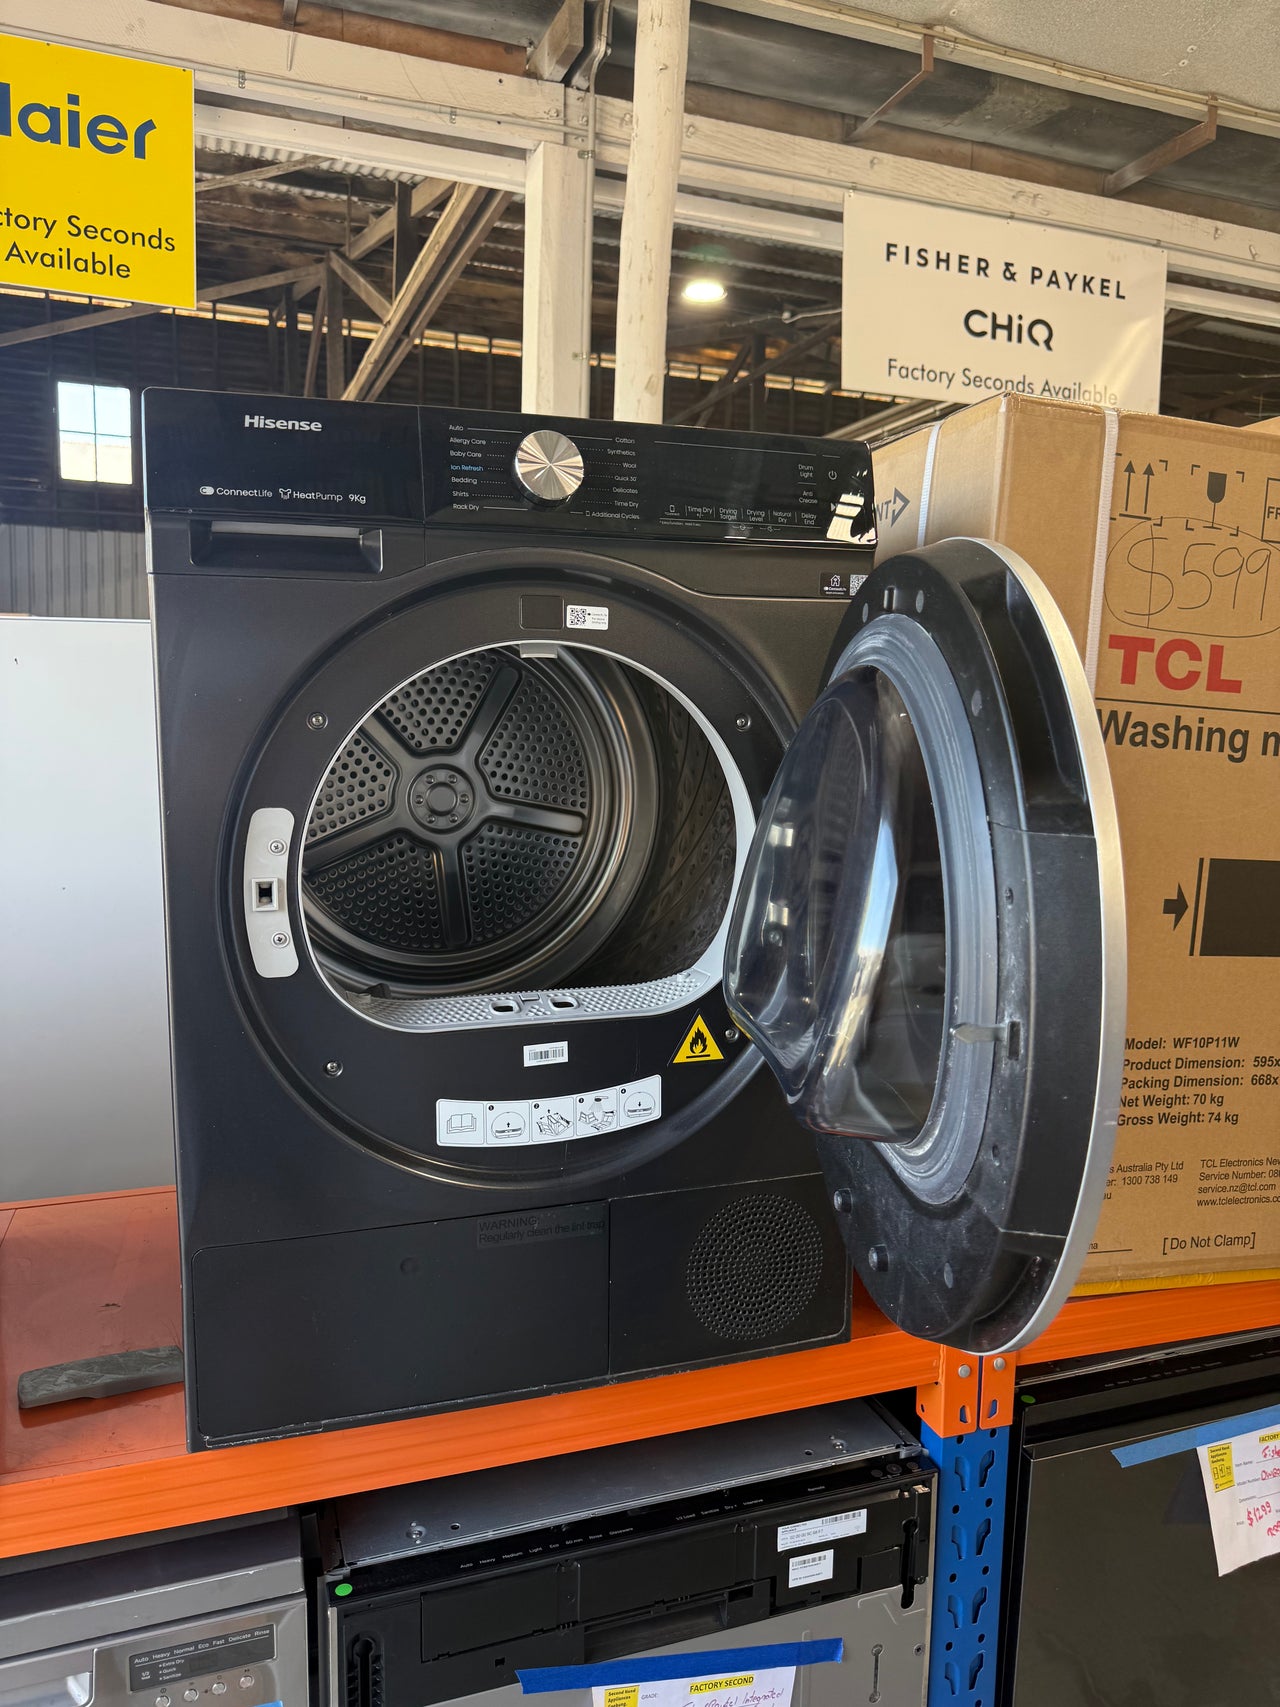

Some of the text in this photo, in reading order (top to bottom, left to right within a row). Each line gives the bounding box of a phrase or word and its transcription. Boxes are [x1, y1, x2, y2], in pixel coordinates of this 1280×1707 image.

[0, 207, 175, 251] tory Seconds
[5, 241, 130, 278] Available
[886, 243, 1126, 300] FISHER & PAYKEL
[963, 309, 1053, 351] CHiQ
[888, 358, 1117, 405] Factory Seconds Available
[244, 415, 322, 431] Hisense
[450, 437, 469, 445] Allergy
[217, 487, 366, 504] ConnectLife HeatPump 9Kg
[703, 506, 712, 514] Dry
[720, 508, 737, 516] Drying
[747, 509, 765, 517] Drying
[1124, 524, 1271, 629] $599
[1108, 634, 1242, 694] TCL
[1096, 709, 1249, 763] Washing
[1125, 1037, 1240, 1050] Model: WF10P11W
[1123, 1058, 1171, 1071] Product
[1175, 1058, 1245, 1069] Dimension:
[1121, 1074, 1279, 1090] Packing Dimension: 668x
[1120, 1094, 1224, 1108] Net Weight: 70 kg
[1117, 1112, 1239, 1126] Gross Weight: 74 kg
[1116, 1163, 1152, 1173] Australia
[1155, 1162, 1168, 1173] Pty
[1171, 1161, 1184, 1170] Ltd
[1201, 1159, 1217, 1168] TCL
[1220, 1158, 1263, 1168] Electronics
[1122, 1176, 1142, 1185] 1300
[1145, 1175, 1160, 1184] 738
[1164, 1174, 1178, 1183] 149
[1199, 1172, 1230, 1181] Service
[1232, 1170, 1266, 1180] Number:
[1198, 1183, 1276, 1194] service.nz@tcl.com
[480, 1230, 524, 1243] Regularly
[527, 1227, 552, 1237] clean
[554, 1223, 570, 1233] the
[1190, 1236, 1210, 1248] Not
[1214, 1232, 1256, 1249] Clamp]
[1247, 1501, 1271, 1527] $1299
[502, 1551, 523, 1559] Medium
[152, 1652, 170, 1660] Heavy
[174, 1646, 195, 1655] Normal
[229, 1633, 251, 1642] Delicate
[690, 1676, 753, 1692] FACTORY SECOND
[608, 1695, 630, 1703] Appliances
[743, 1689, 784, 1704] Integrated
